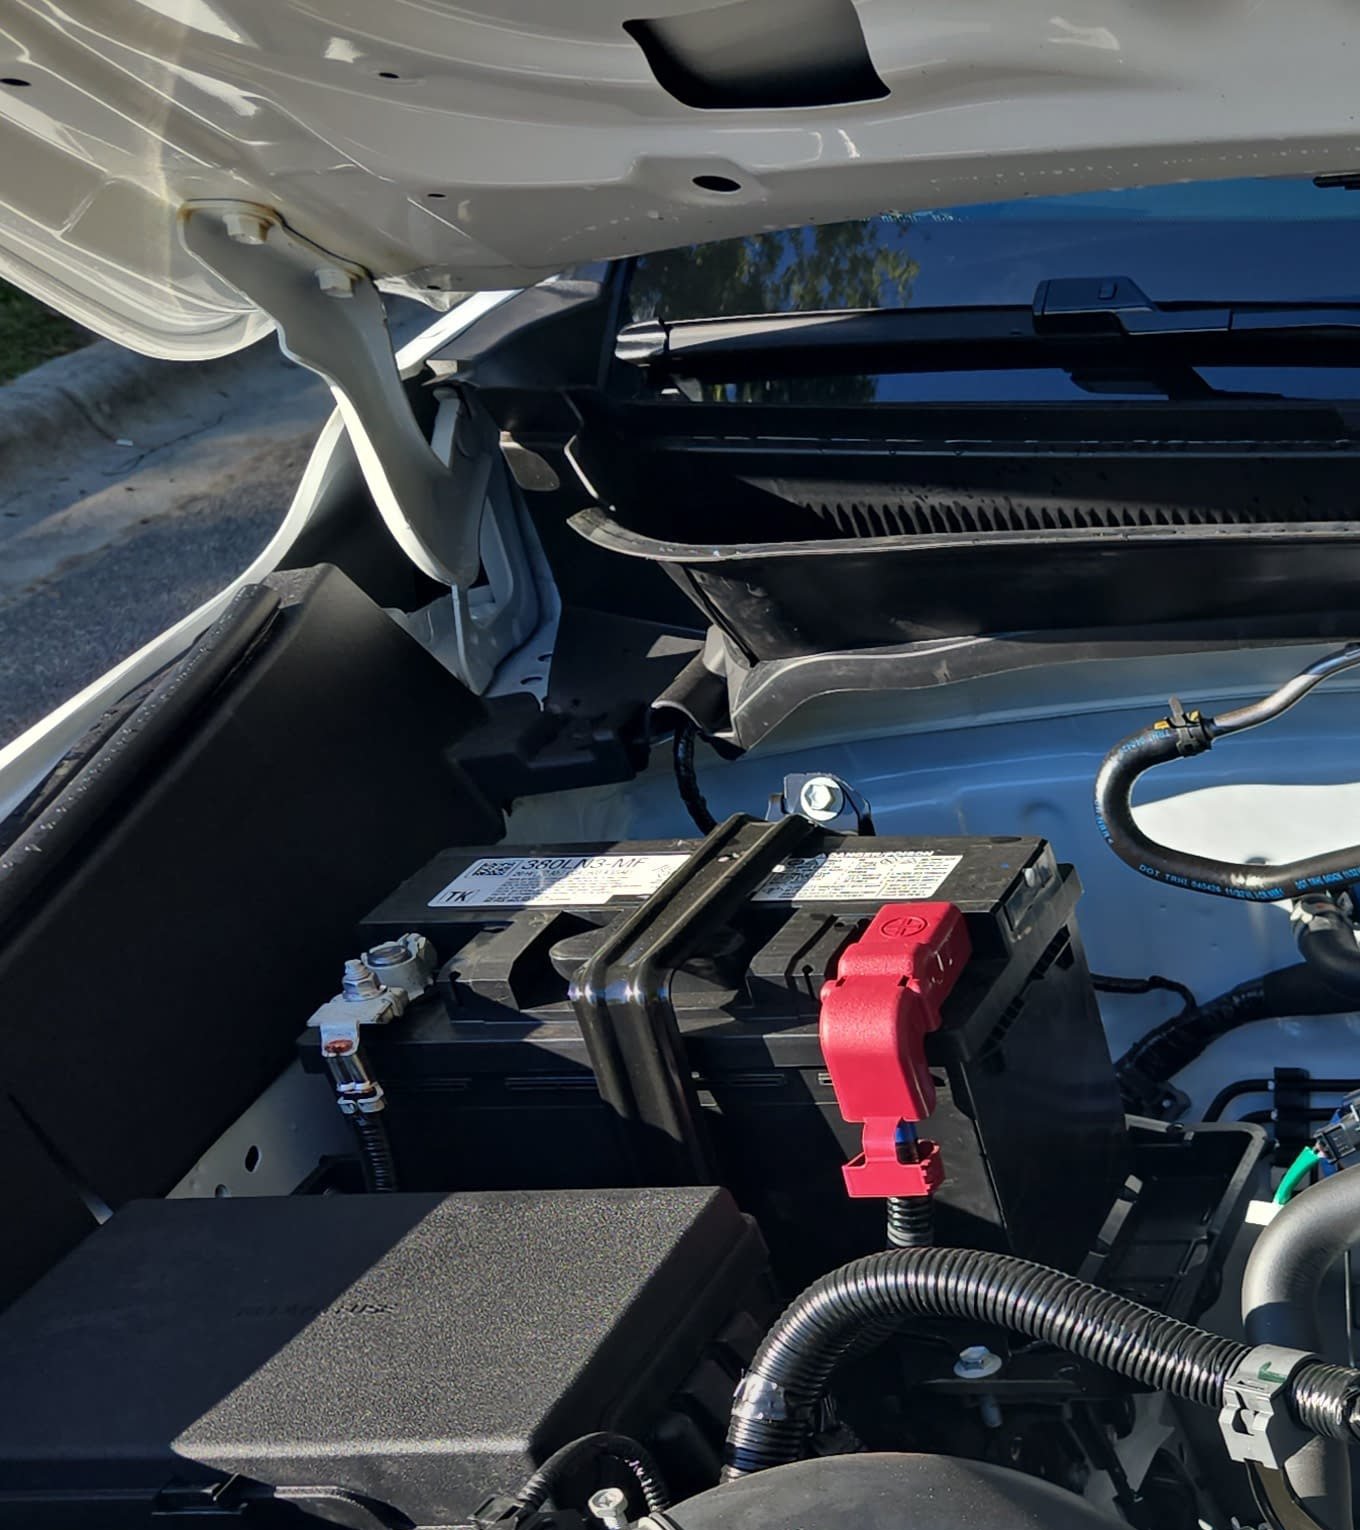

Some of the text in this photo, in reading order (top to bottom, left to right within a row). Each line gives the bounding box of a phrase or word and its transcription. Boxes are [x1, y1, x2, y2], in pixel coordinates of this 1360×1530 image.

[520, 858, 650, 870] 380LN3-MF
[1139, 864, 1160, 877] DOT
[445, 890, 474, 902] TK
